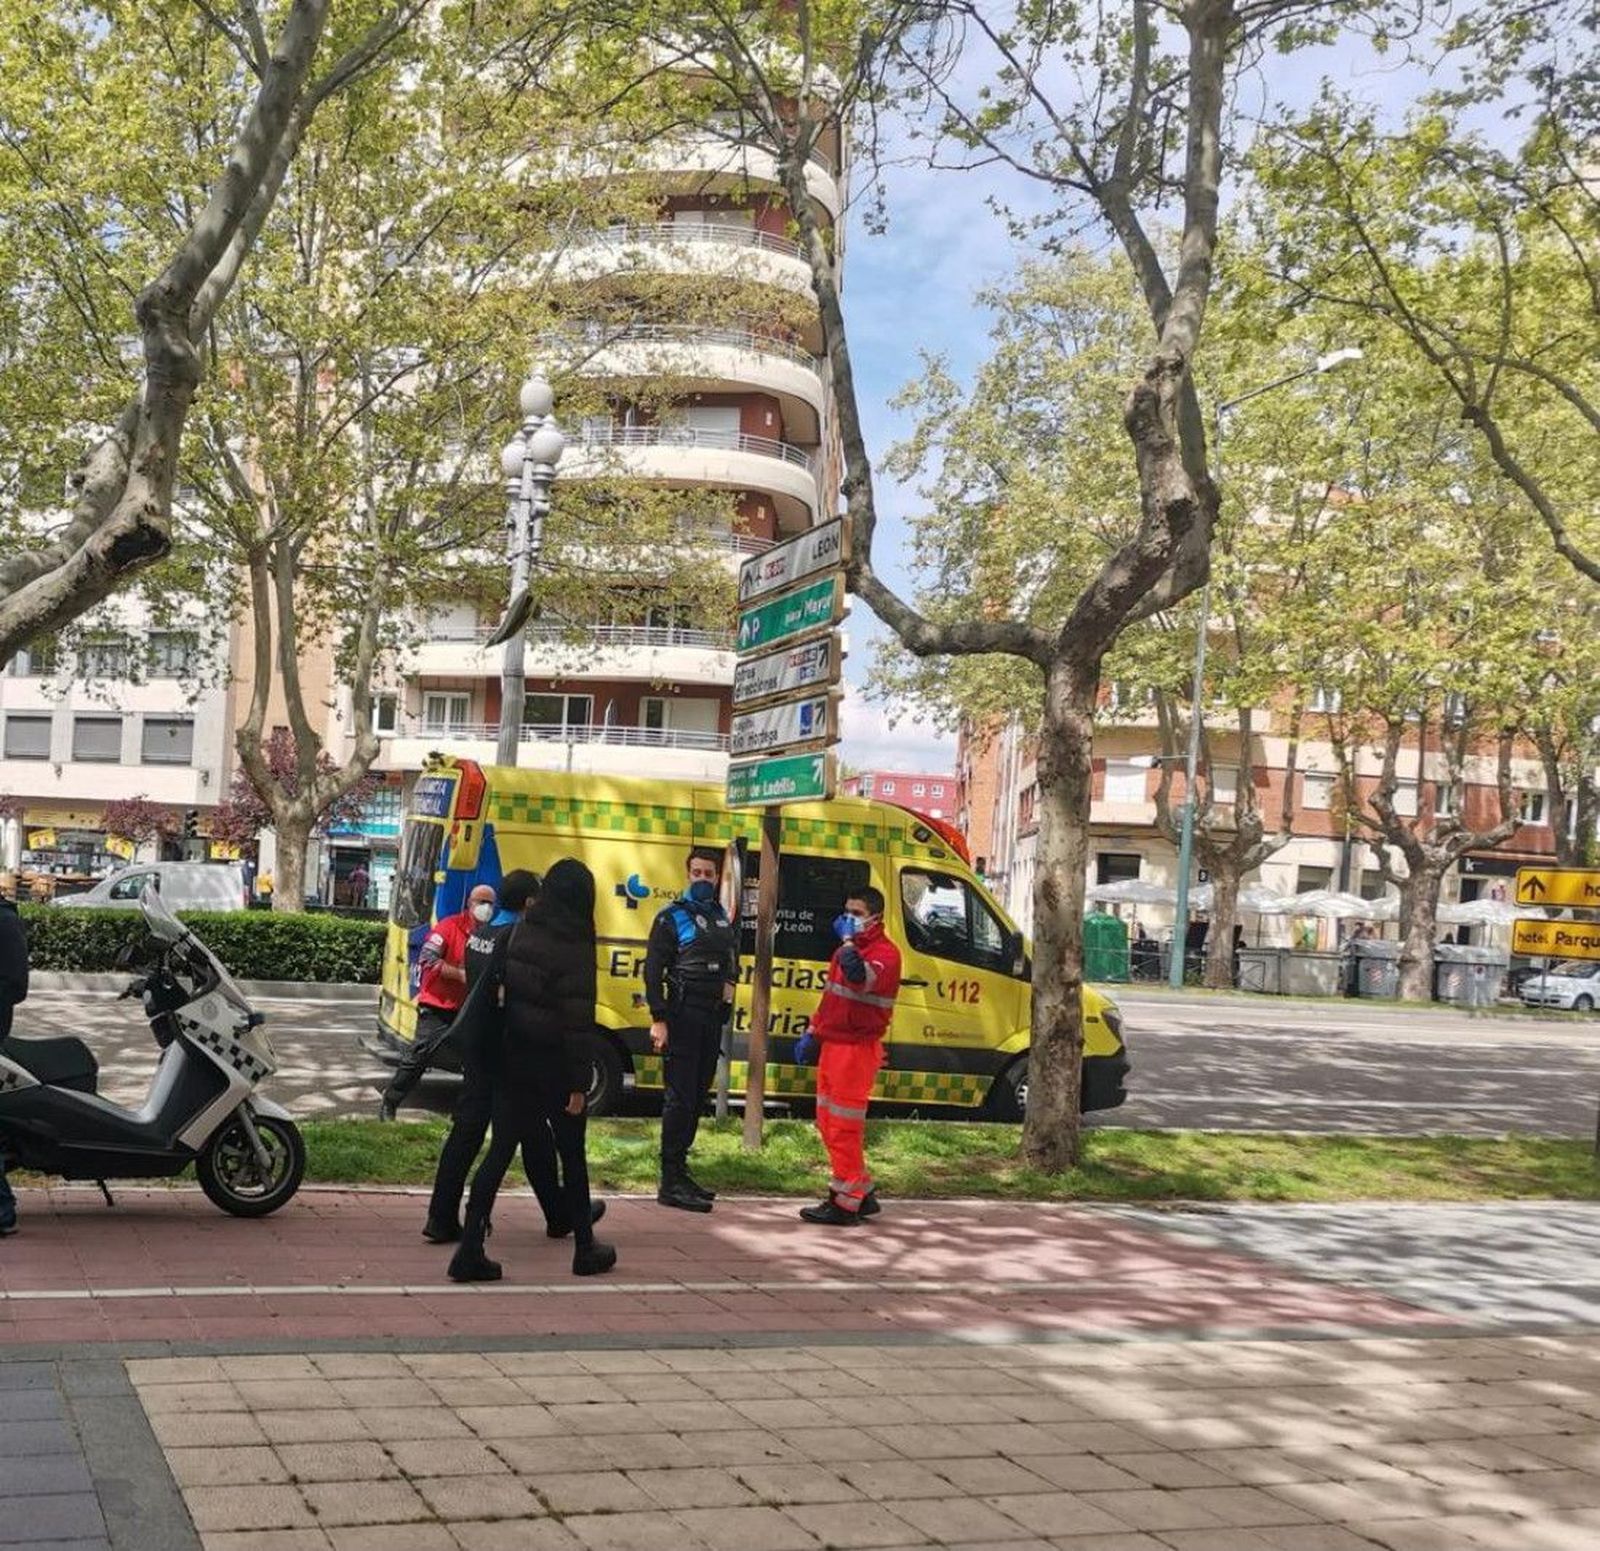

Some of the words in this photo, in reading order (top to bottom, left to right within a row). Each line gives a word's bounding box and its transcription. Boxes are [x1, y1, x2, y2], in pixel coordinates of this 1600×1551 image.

[752, 616, 761, 641] P
[799, 910, 814, 920] de
[948, 980, 980, 1004] 112
